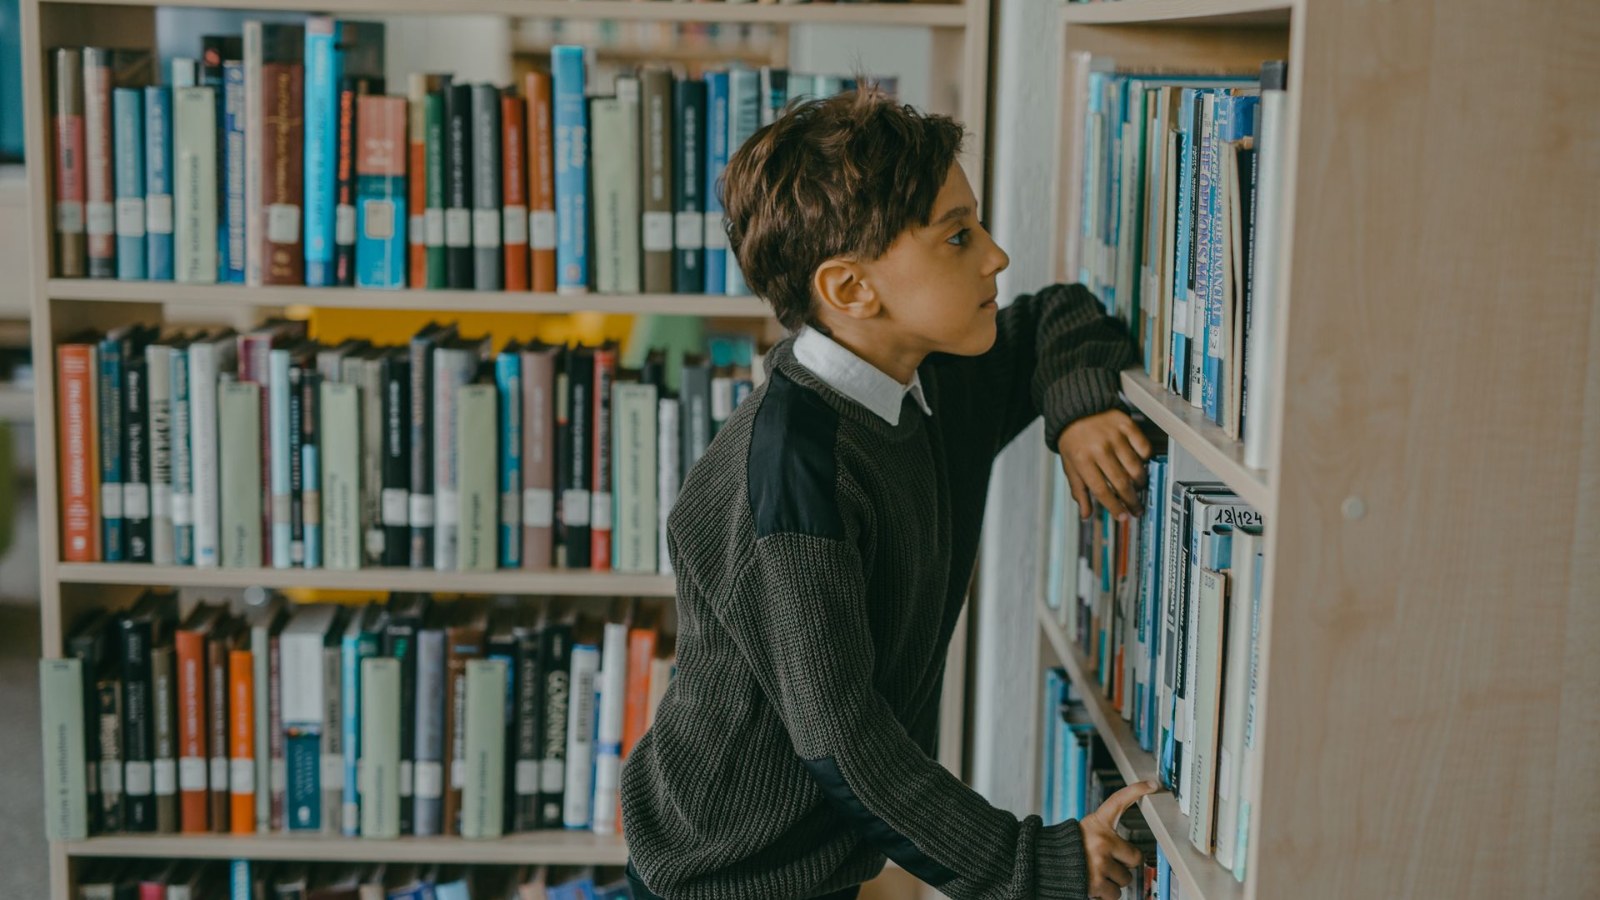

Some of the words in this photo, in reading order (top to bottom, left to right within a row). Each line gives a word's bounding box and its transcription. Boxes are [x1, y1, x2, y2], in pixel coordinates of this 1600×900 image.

[1200, 133, 1212, 171] THE
[1196, 173, 1211, 257] OPTIONS
[1213, 243, 1224, 319] FINANCIAL
[1179, 550, 1187, 626] INTERNATIONAL
[1192, 754, 1203, 843] Production
